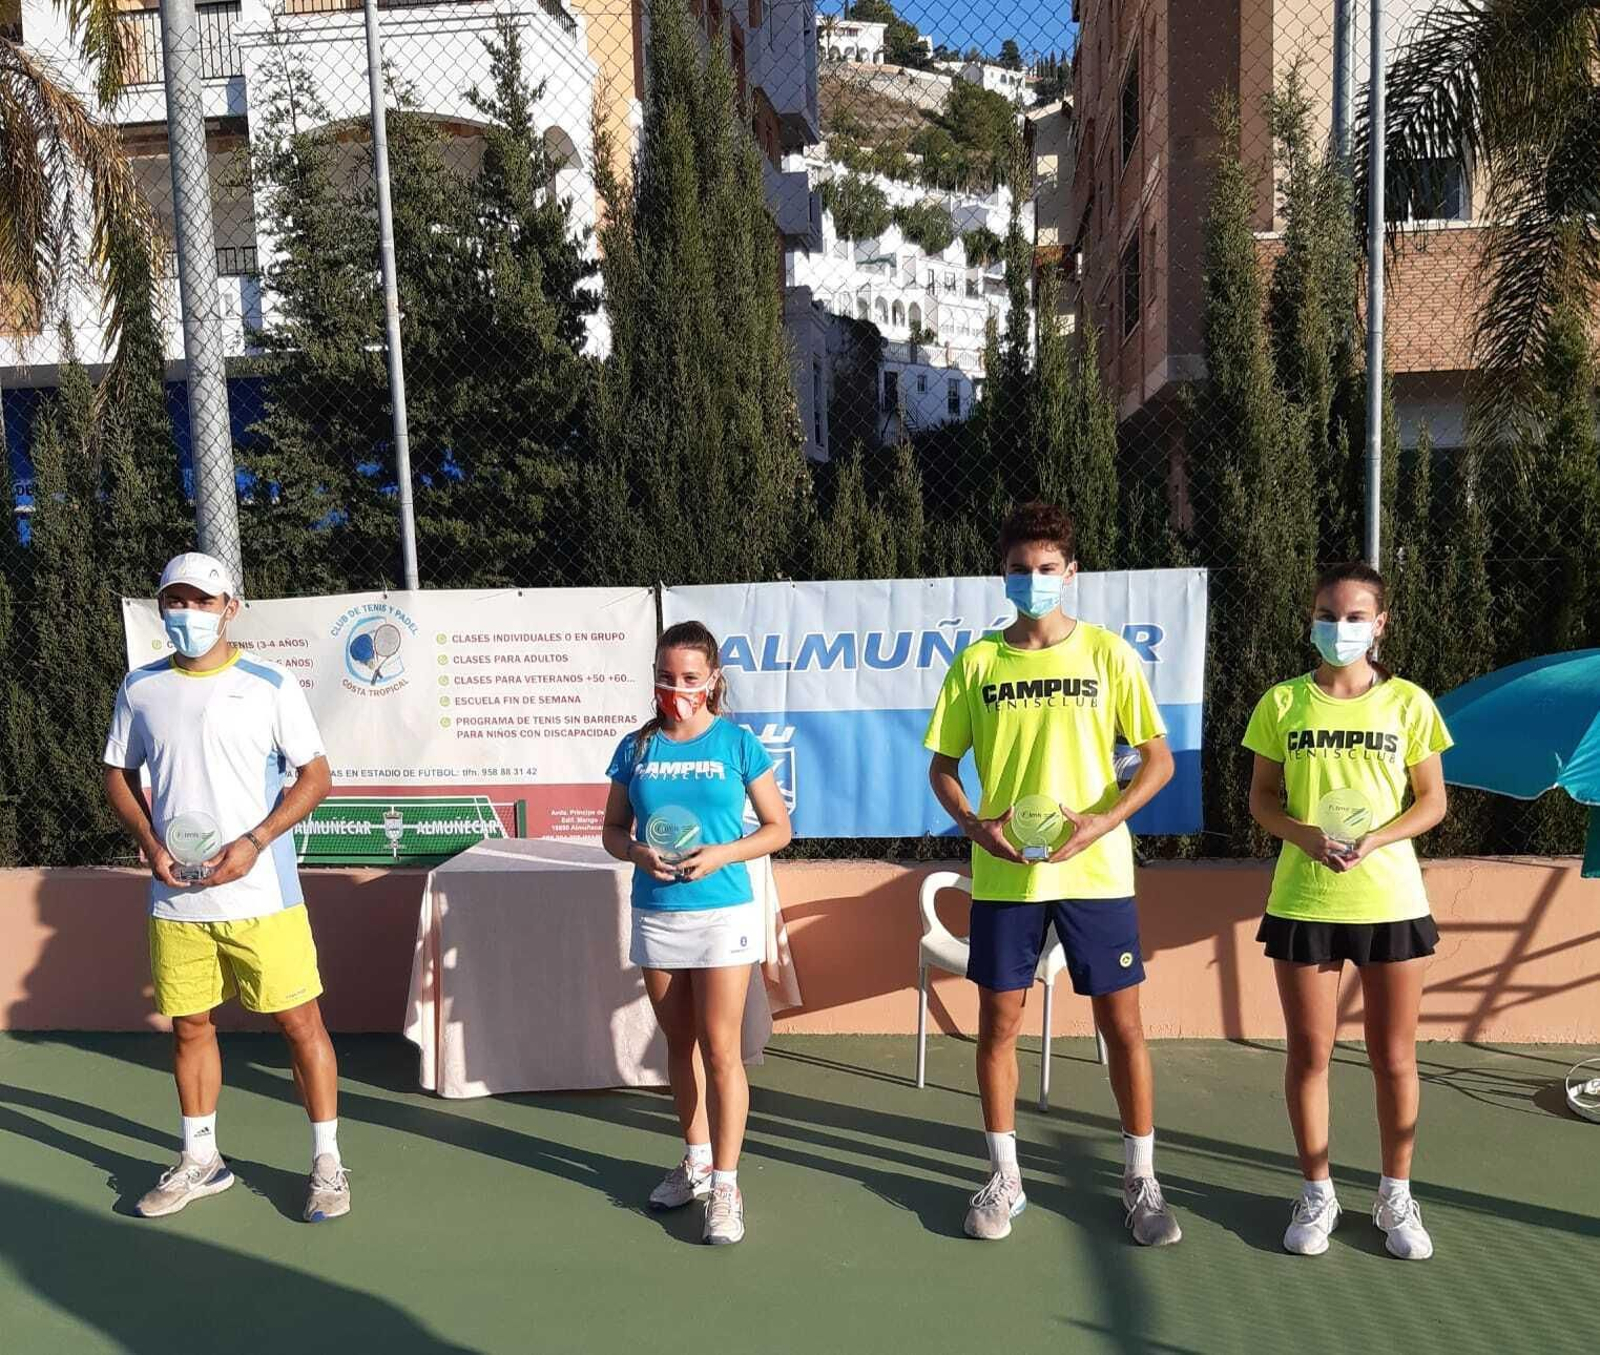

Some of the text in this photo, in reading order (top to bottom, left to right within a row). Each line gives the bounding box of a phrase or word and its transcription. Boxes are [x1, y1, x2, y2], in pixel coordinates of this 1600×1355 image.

[331, 615, 349, 637] CLUB
[348, 607, 361, 617] DE
[363, 604, 387, 613] TENIS
[395, 610, 419, 636] PADEL
[257, 640, 276, 649] (3-4
[279, 638, 309, 648] AÑOS)
[452, 632, 625, 643] CLASES INDIVIDUALES O EN GRUPO
[718, 615, 1165, 673] ALMUÑR
[285, 658, 314, 668] AÑOS)
[453, 654, 569, 664] CLASES PARA ADULTOS
[454, 676, 492, 684] CLASES
[495, 675, 522, 684] PARA
[524, 674, 583, 683] VETERANOS
[586, 674, 605, 683] +50
[343, 679, 409, 697] COSTA TROPICAL
[982, 678, 1098, 703] CAMPUS
[455, 695, 581, 705] ESCUELA FIN DE SEMANA
[985, 697, 1098, 713] TENISCLUB
[456, 715, 638, 726] PROGRAMA DE TENIS SIN BARRERAS
[457, 728, 617, 739] PARA NIÑOS CON DISCAPACIDAD
[1287, 730, 1398, 753] CAMPUS
[1289, 748, 1396, 764] TENISCLUB
[346, 769, 358, 777] EN
[361, 769, 400, 777] ESTADIO
[403, 769, 416, 777] DE
[482, 768, 498, 776] 958
[501, 768, 511, 776] 88
[526, 767, 537, 775] 42
[294, 816, 371, 835] ALMUÑÉCAR
[417, 816, 498, 835] ALMUÑÉCAR
